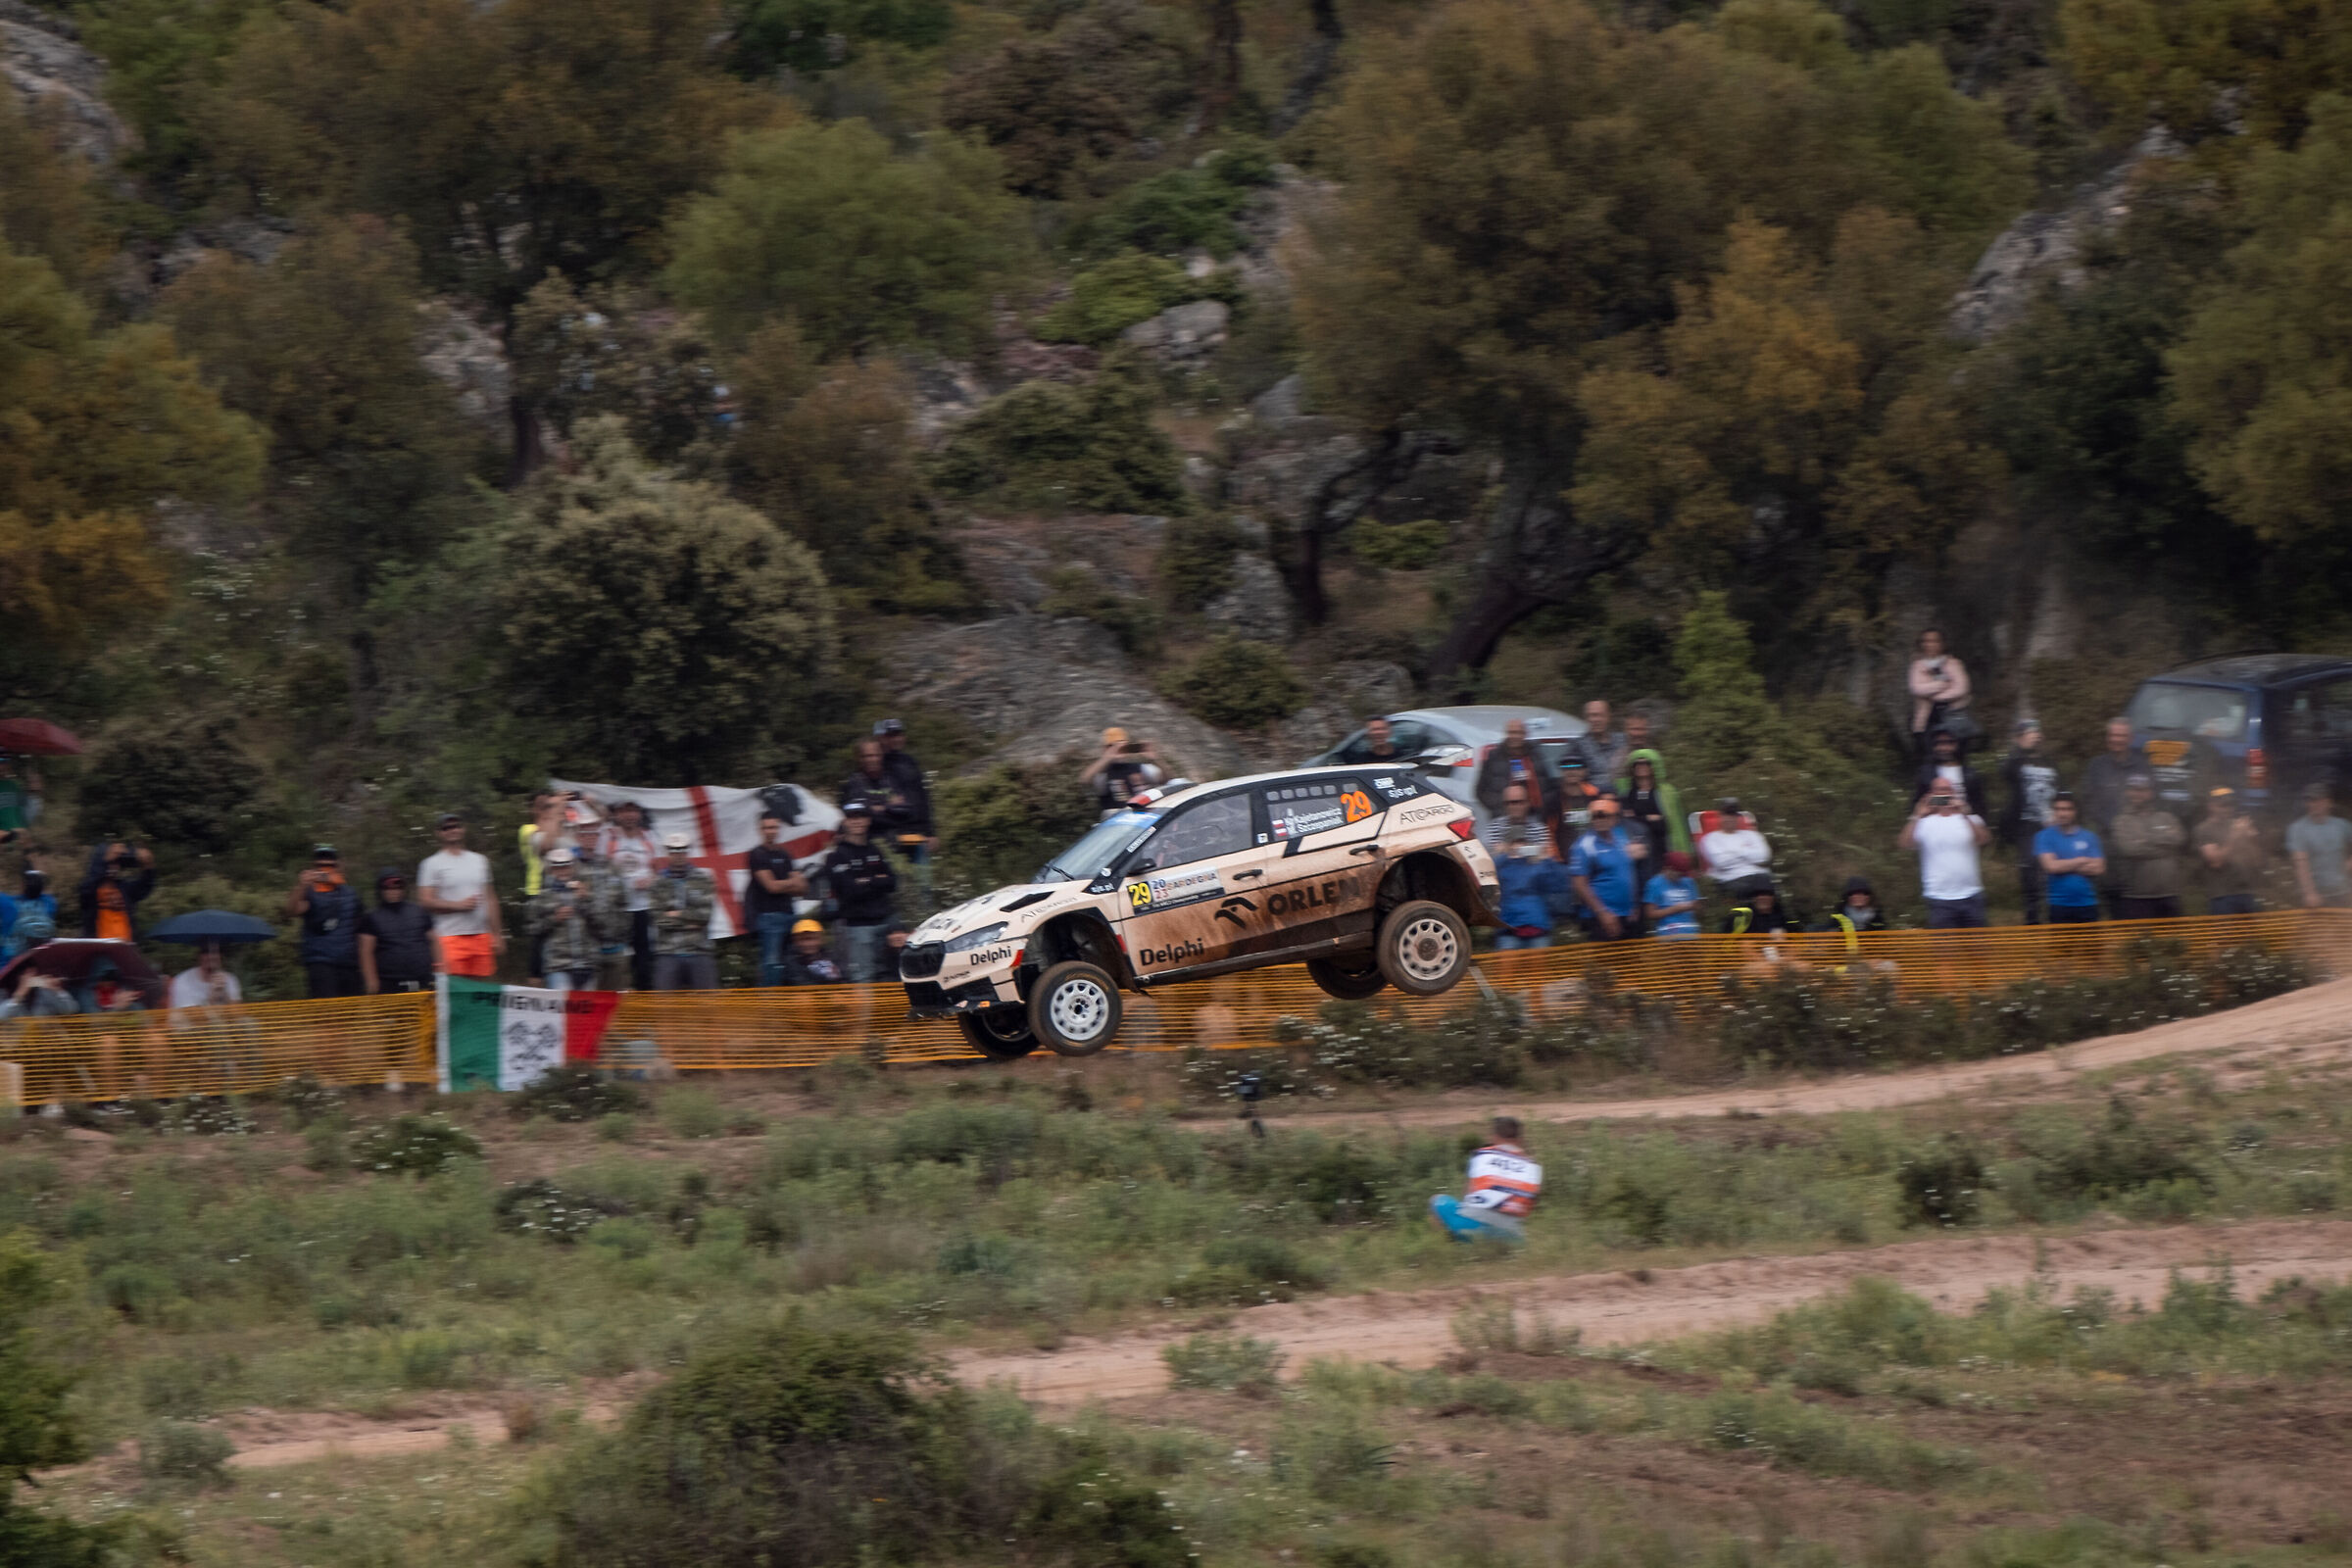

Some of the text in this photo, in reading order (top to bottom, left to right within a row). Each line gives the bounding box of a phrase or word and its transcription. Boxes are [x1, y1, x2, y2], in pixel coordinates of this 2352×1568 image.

[1340, 790, 1373, 823] 29
[1128, 882, 1152, 906] 29
[970, 946, 1012, 965] Delphi
[1140, 937, 1205, 966] Delphi
